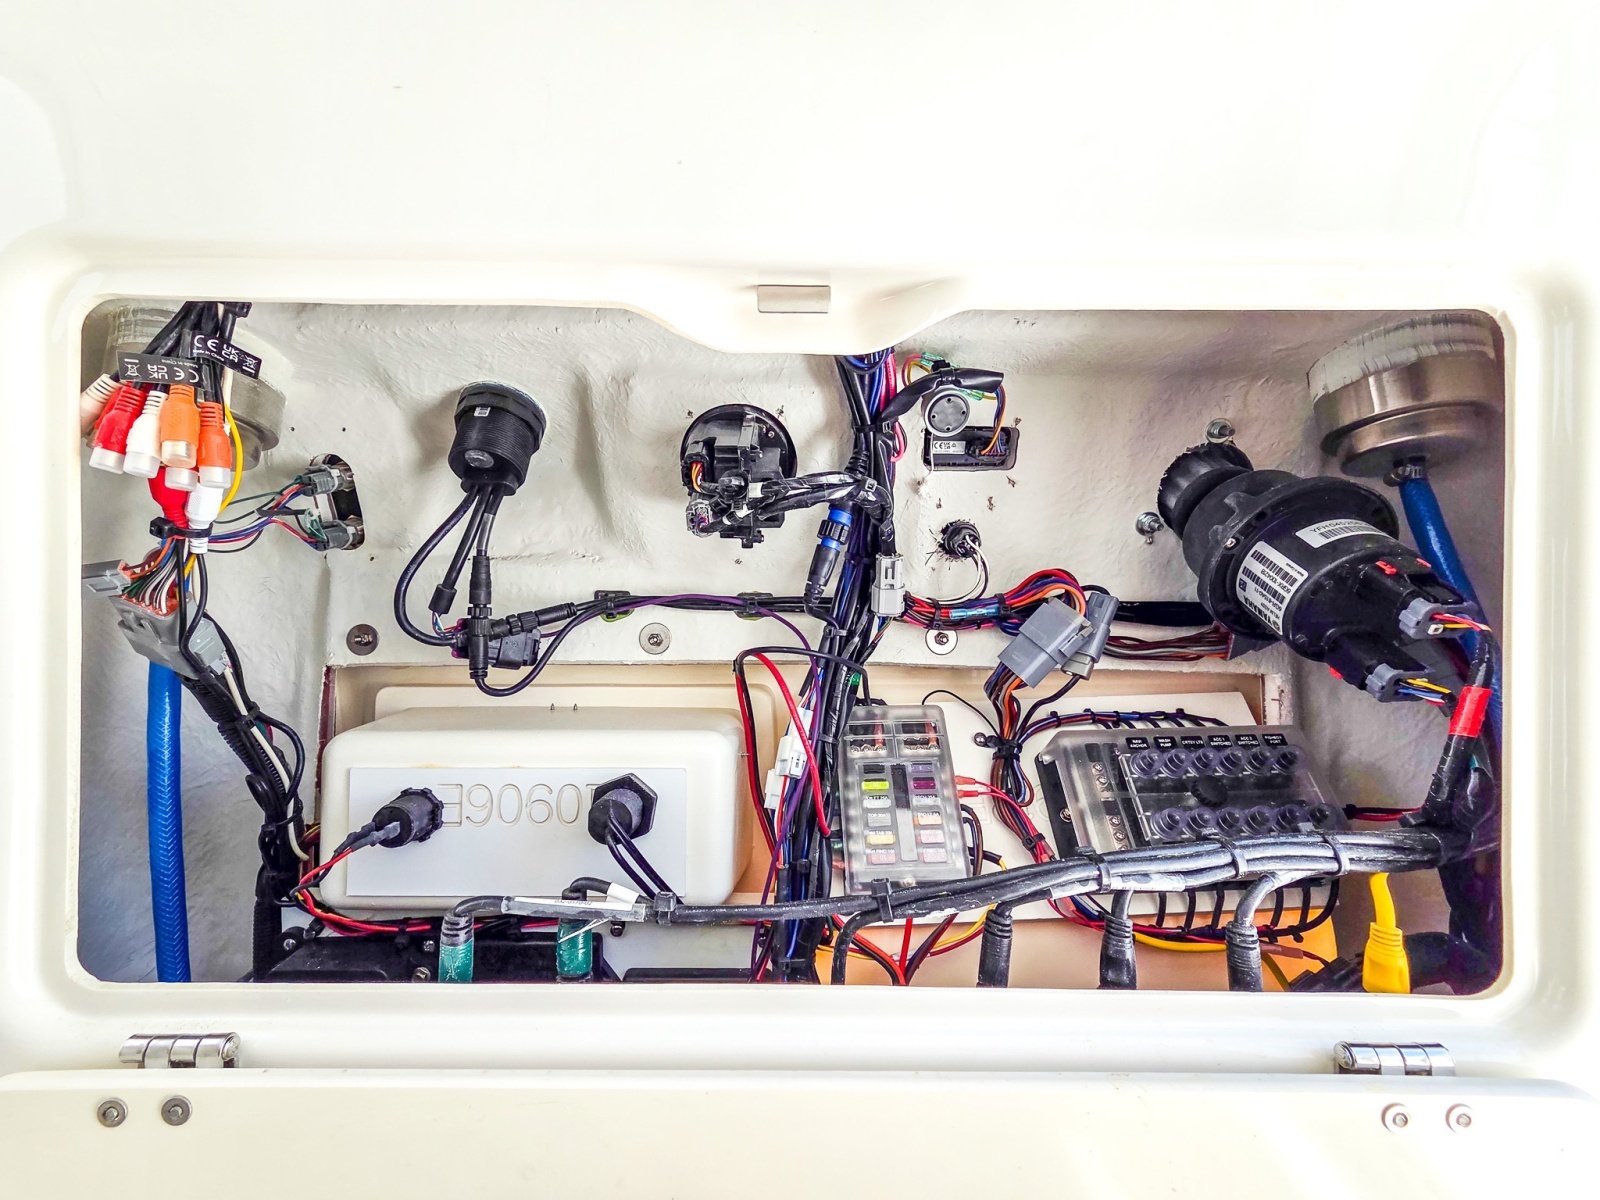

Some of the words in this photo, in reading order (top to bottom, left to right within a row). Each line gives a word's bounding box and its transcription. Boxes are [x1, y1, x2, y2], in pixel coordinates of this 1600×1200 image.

[194, 335, 219, 352] CE
[173, 367, 200, 383] CE
[1243, 595, 1272, 624] YAMAHA
